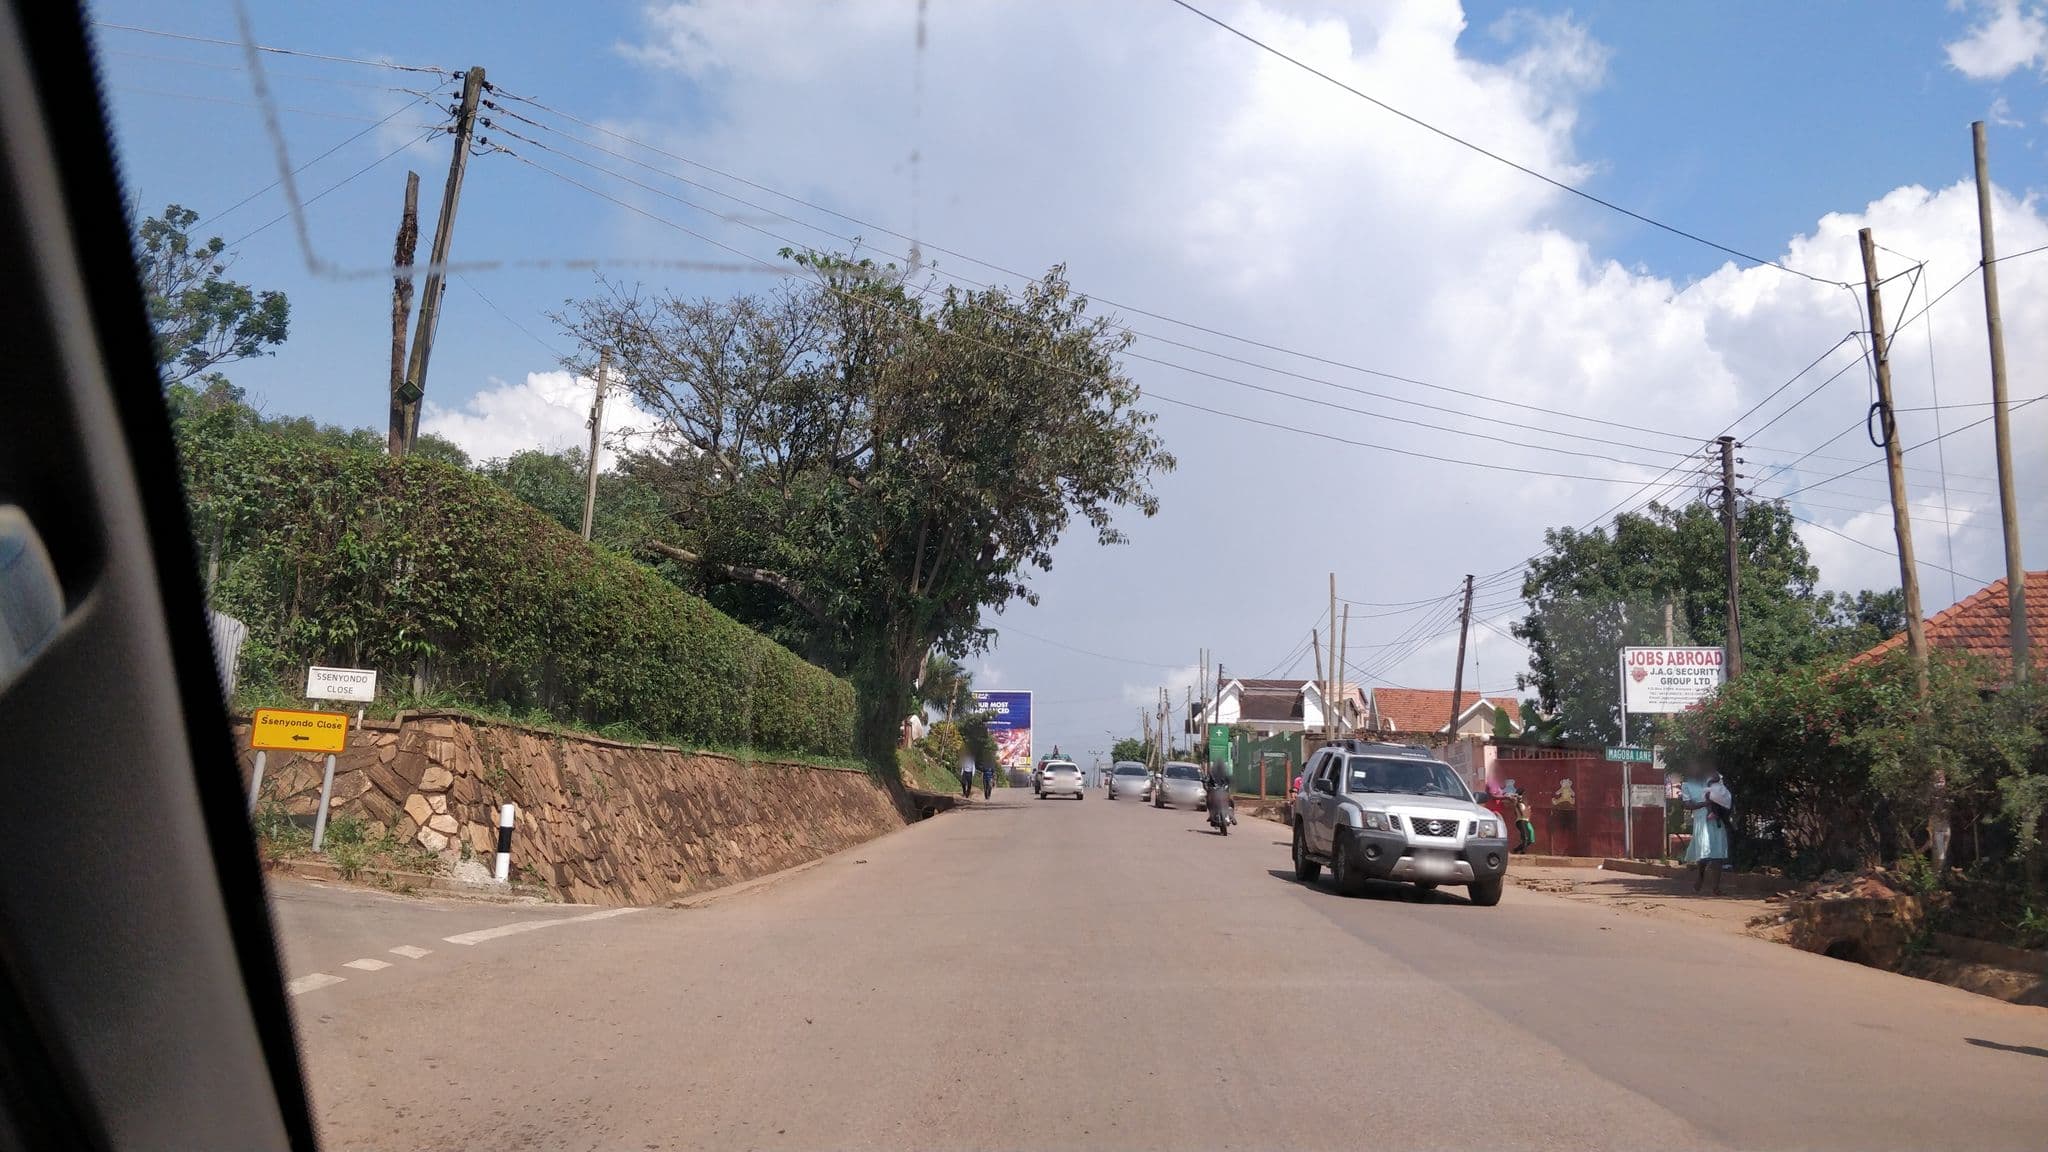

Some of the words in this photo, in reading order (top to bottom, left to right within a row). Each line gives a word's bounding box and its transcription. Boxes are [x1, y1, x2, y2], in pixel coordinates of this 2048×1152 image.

[1628, 651, 1664, 666] JOBS
[1666, 651, 1723, 666] ABROAD
[316, 672, 368, 684] SSENYONDO
[1675, 668, 1721, 676] SECURITY
[1660, 677, 1692, 685] GROUP
[1694, 677, 1711, 685] LTD
[326, 685, 354, 695] CLOSE
[261, 716, 314, 728] Ssenyondo
[316, 720, 343, 730] Close
[1608, 748, 1634, 761] MAGOBA
[1636, 750, 1653, 762] LANE
